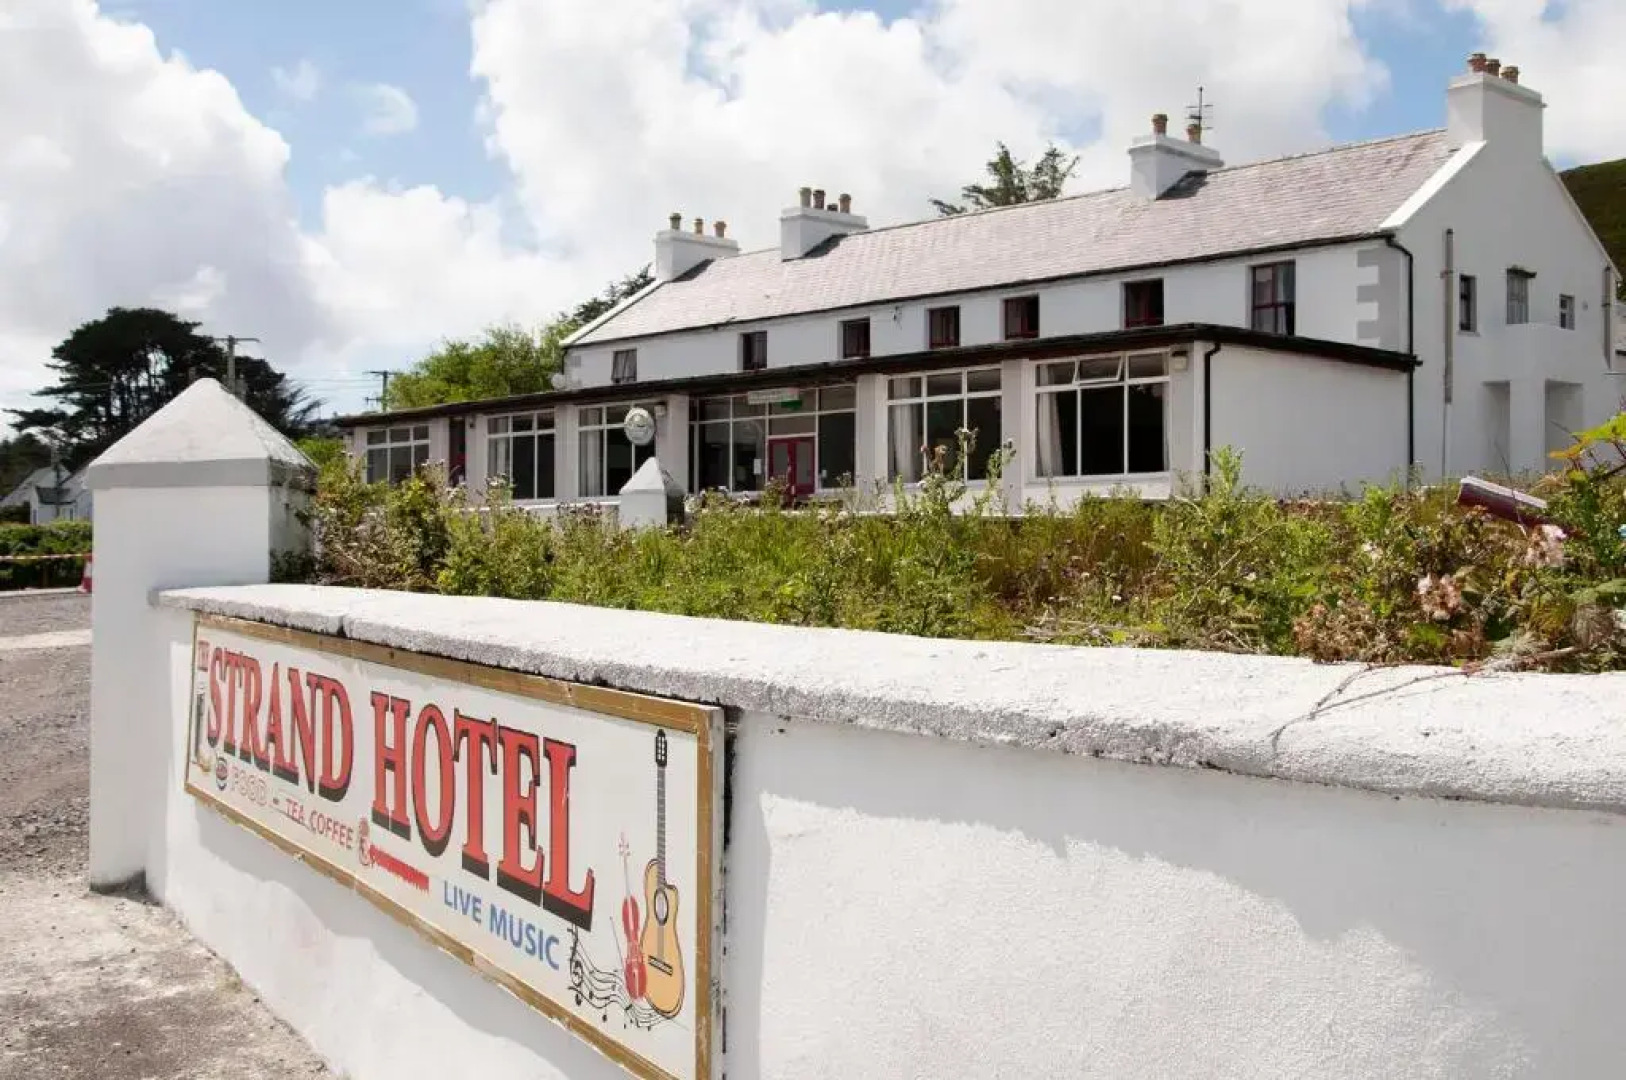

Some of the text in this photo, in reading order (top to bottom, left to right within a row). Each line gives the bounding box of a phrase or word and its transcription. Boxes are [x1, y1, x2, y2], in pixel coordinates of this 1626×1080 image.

[207, 647, 595, 932] STRAND HOTEL
[285, 798, 305, 825] TEA
[310, 809, 354, 850] COFFEE
[443, 880, 560, 970] LIVE MUSIC
